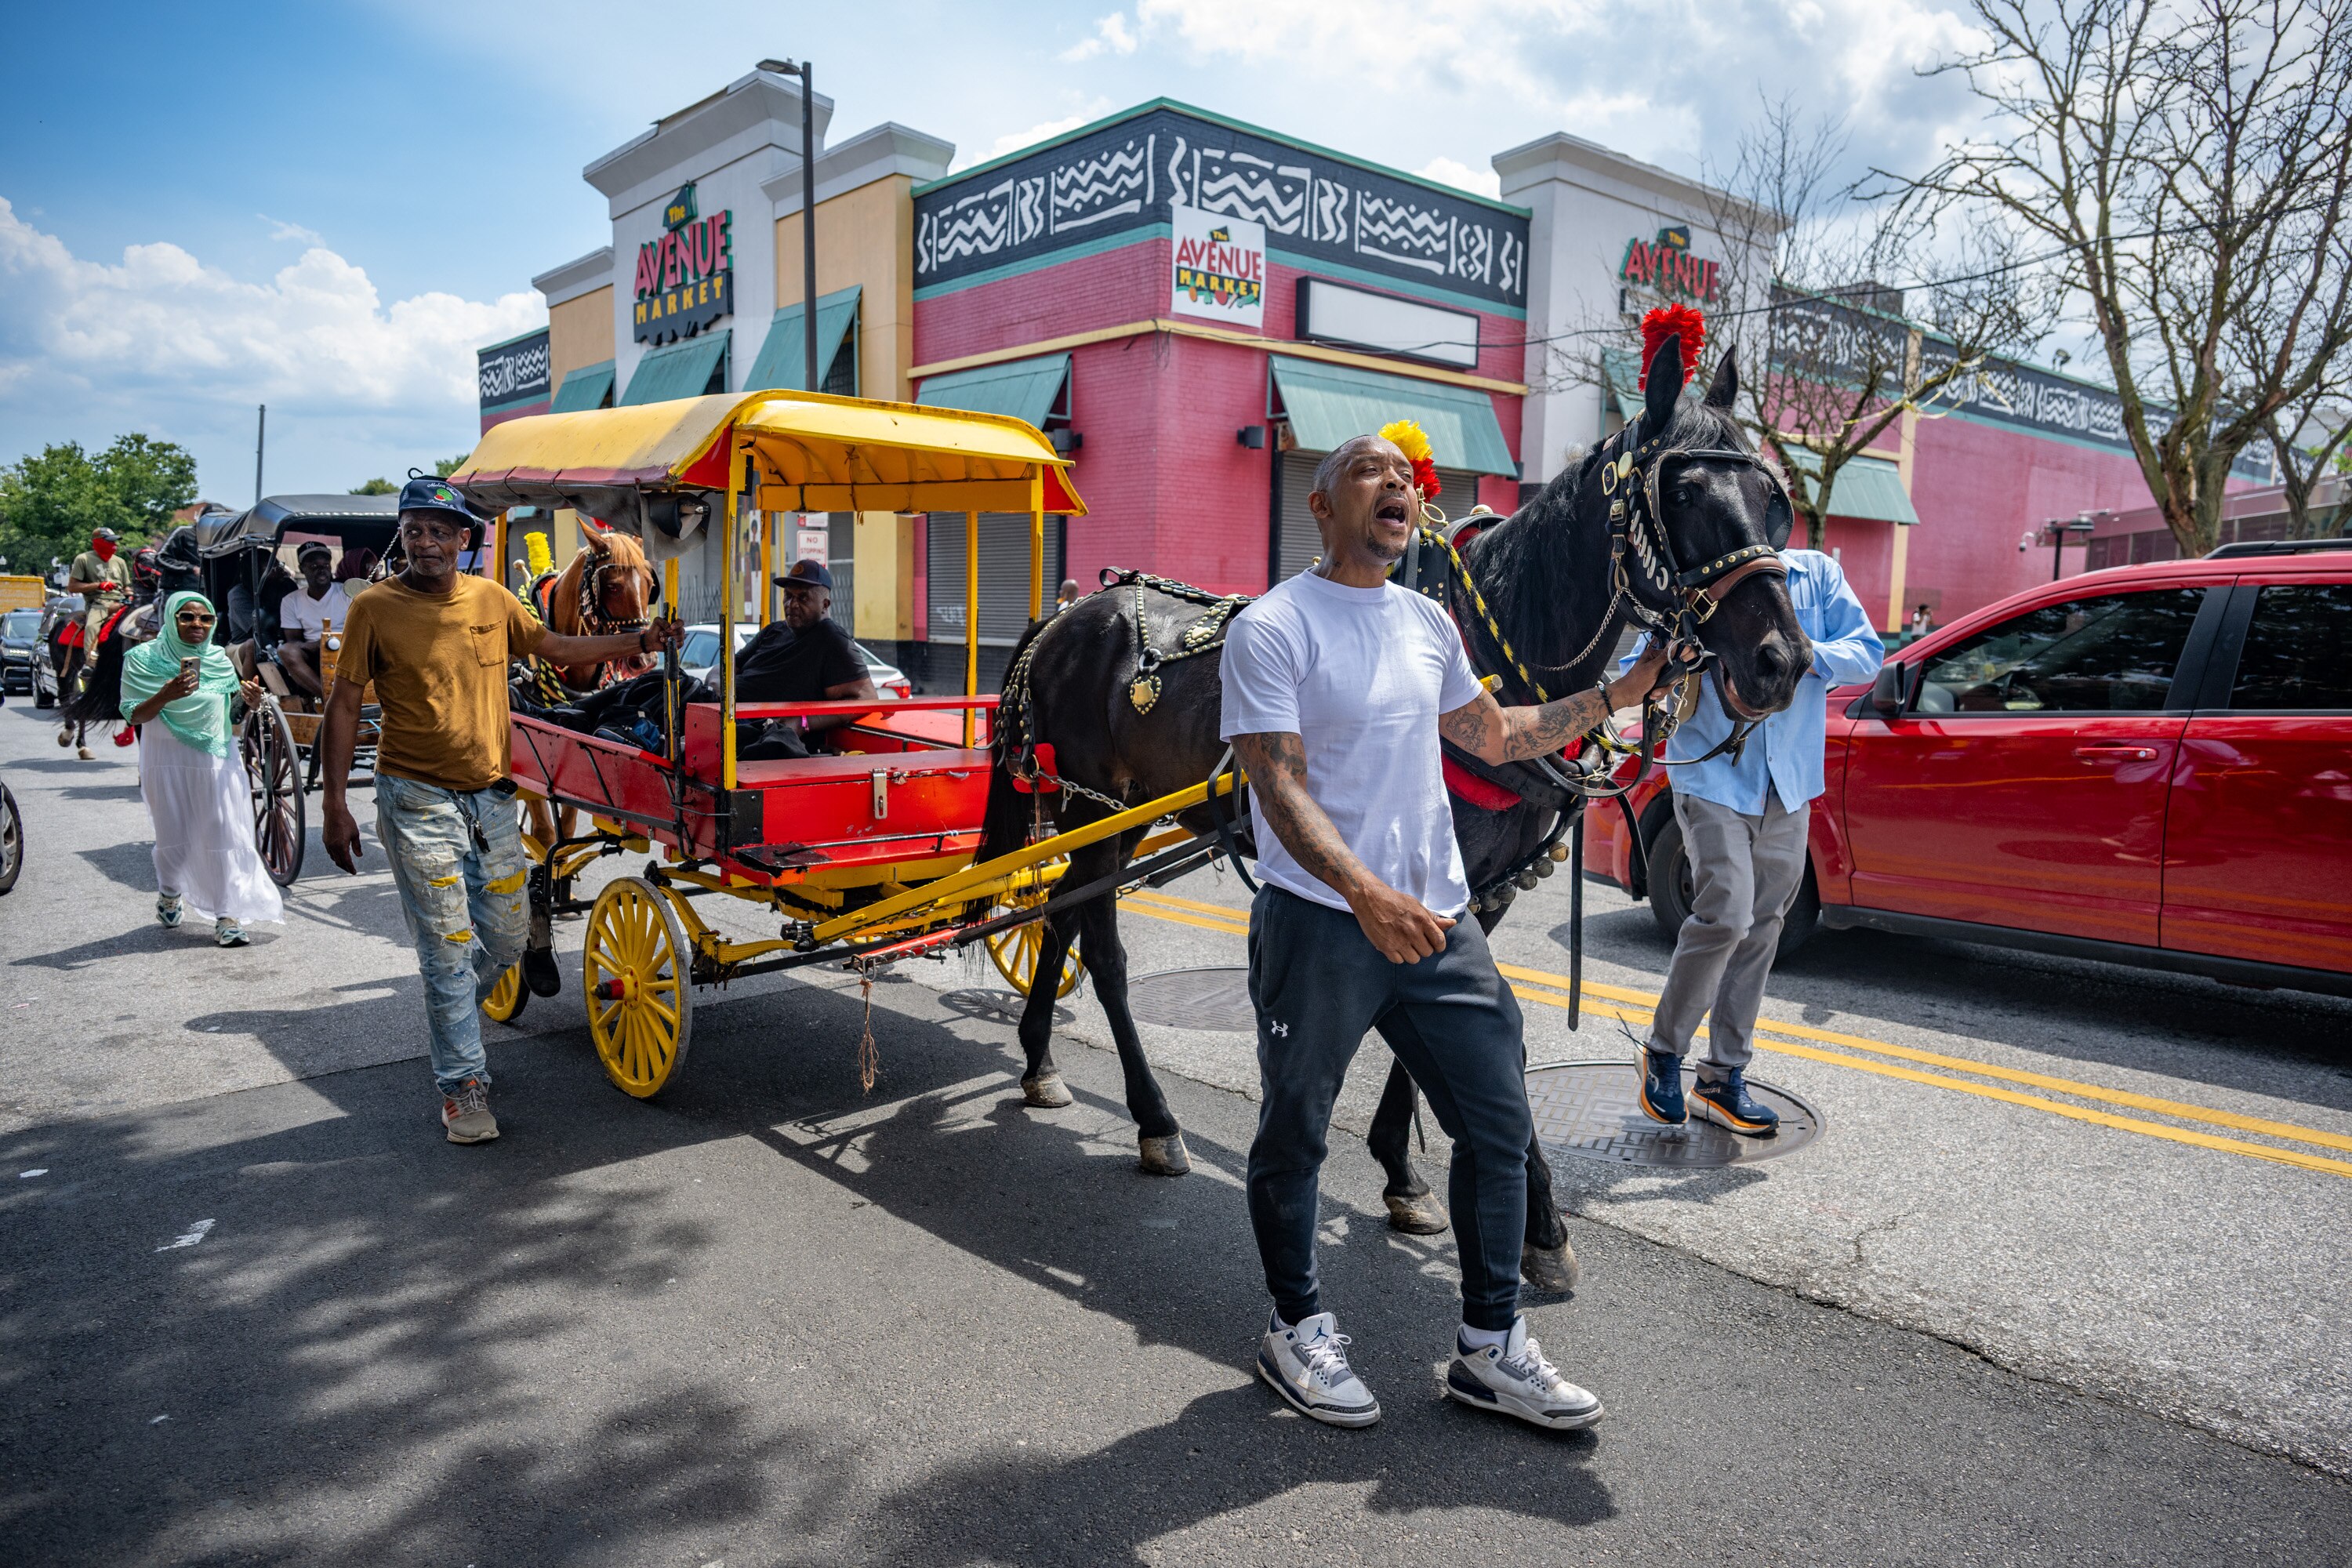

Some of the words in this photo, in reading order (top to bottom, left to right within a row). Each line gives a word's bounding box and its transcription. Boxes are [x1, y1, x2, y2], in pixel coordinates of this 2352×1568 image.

[669, 205, 685, 223] The
[1212, 230, 1229, 241] The
[633, 209, 732, 301] AVENUE
[1176, 235, 1263, 281] AVENUE
[1622, 238, 1719, 303] AVENUE
[636, 276, 724, 325] MARKET
[1179, 269, 1260, 299] MARKET
